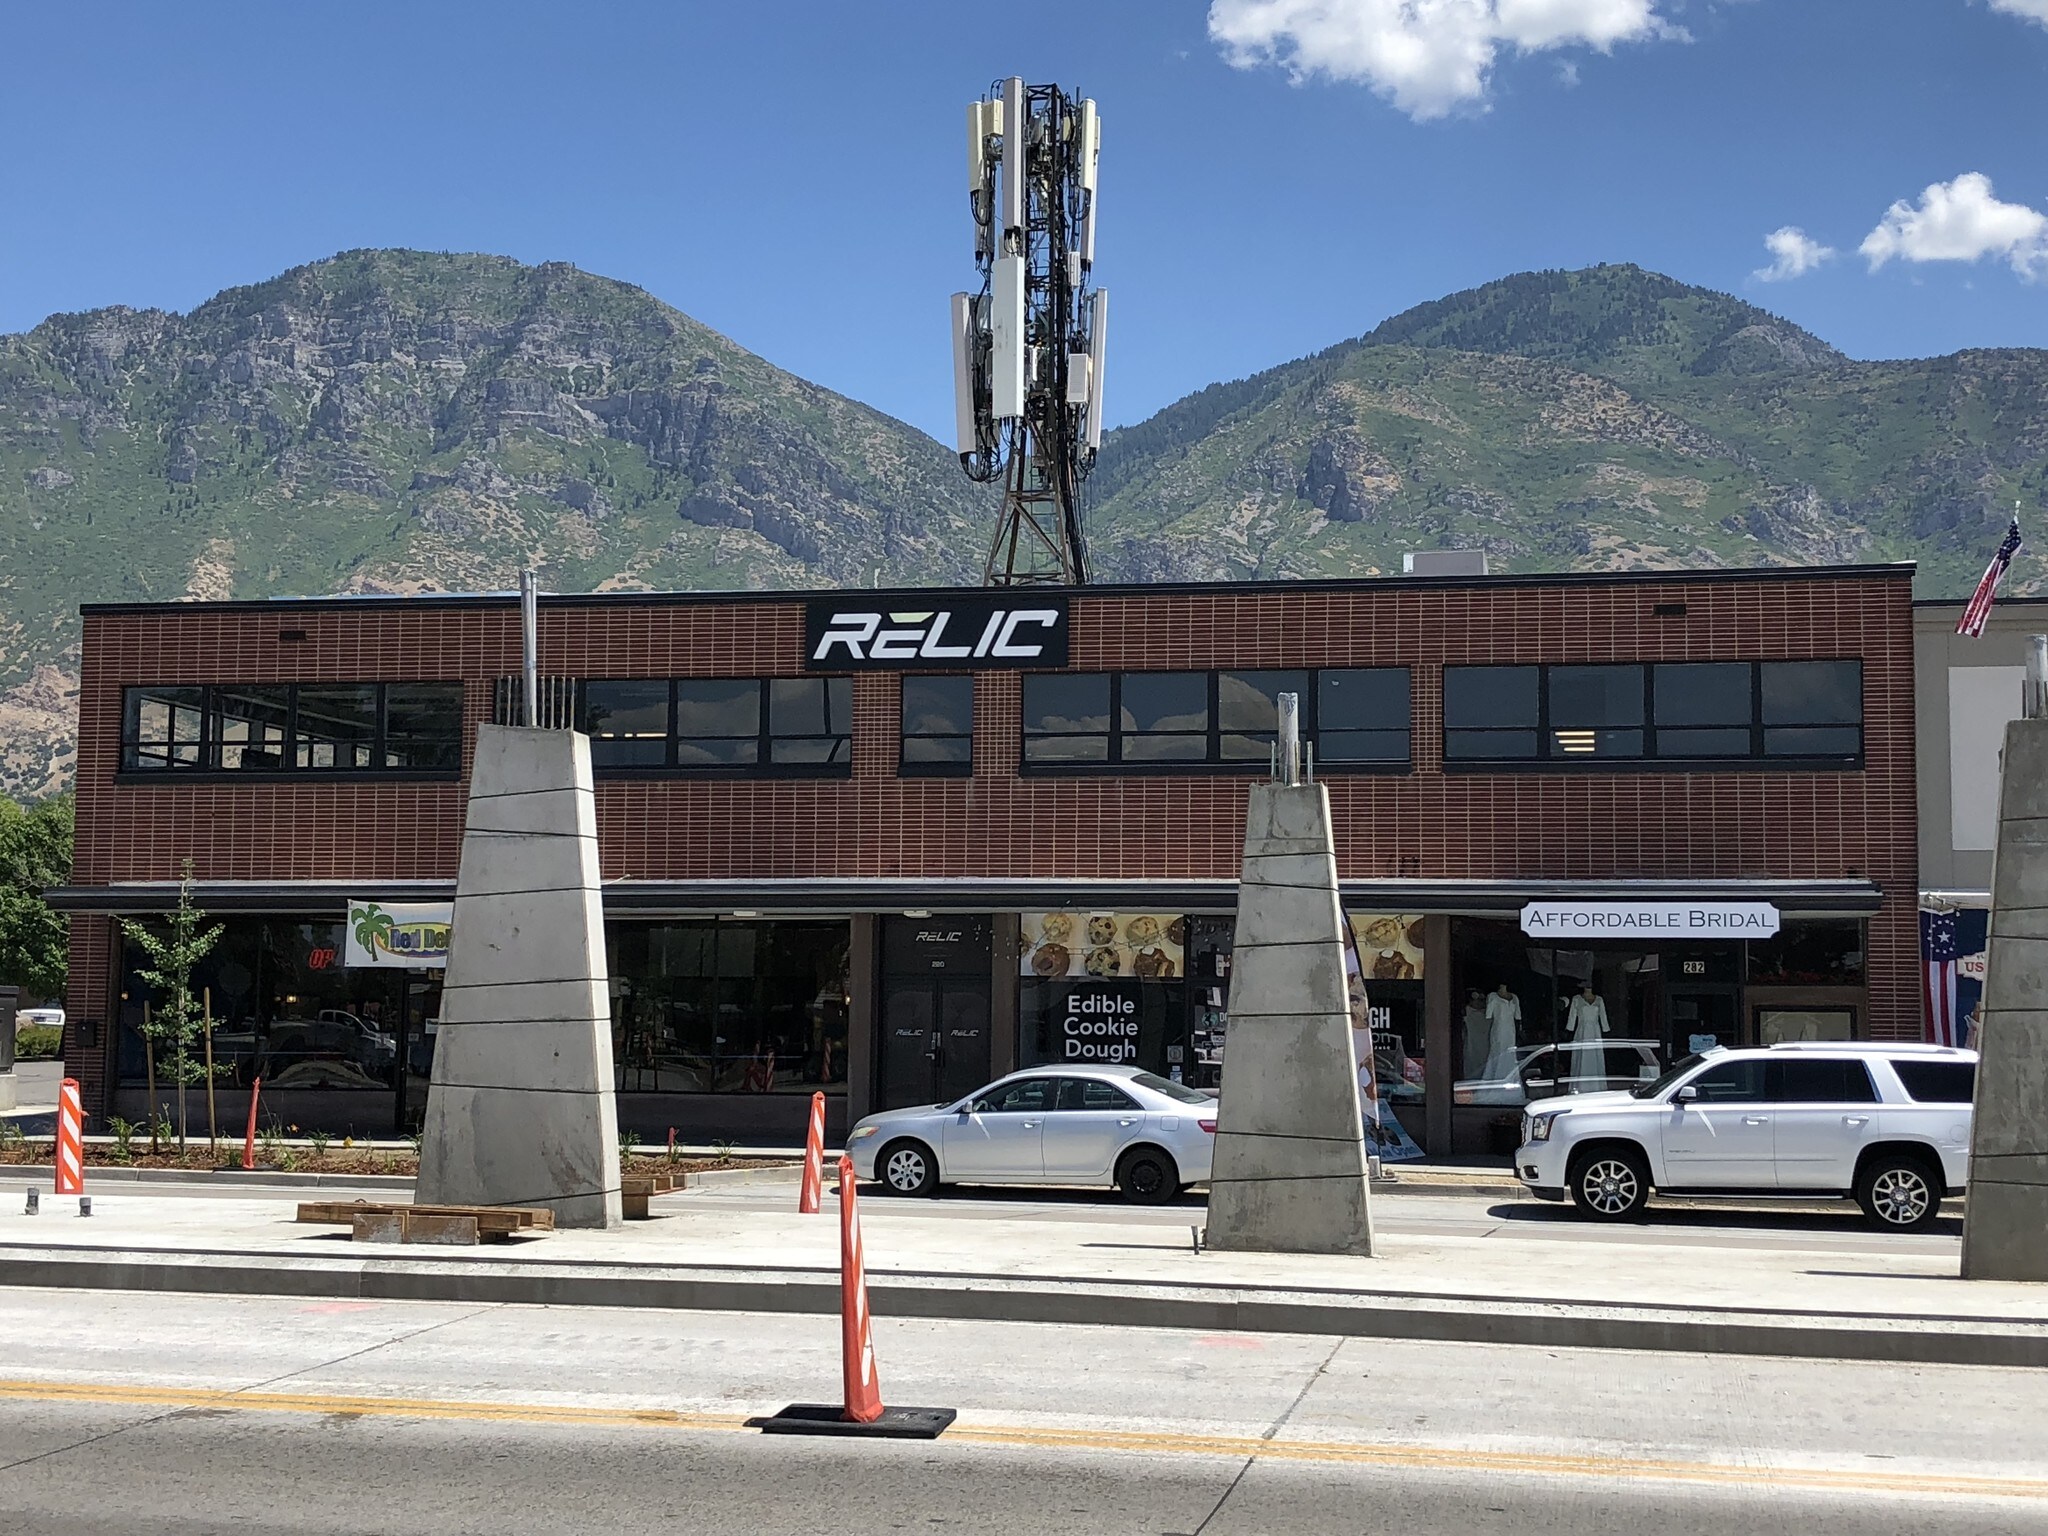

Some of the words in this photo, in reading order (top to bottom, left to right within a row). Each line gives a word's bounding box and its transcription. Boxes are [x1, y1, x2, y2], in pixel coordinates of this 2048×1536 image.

[812, 609, 1059, 660] RELIC
[1528, 910, 1681, 928] AFFORDABLE
[1688, 910, 1775, 928] BRIDAL
[915, 931, 962, 942] RELIC
[1685, 962, 1704, 973] 282
[1068, 994, 1135, 1014] Edible
[896, 1028, 923, 1036] RELIC
[950, 1029, 979, 1037] RELIC
[1063, 1016, 1139, 1036] Cookie
[1065, 1038, 1136, 1063] Dough
